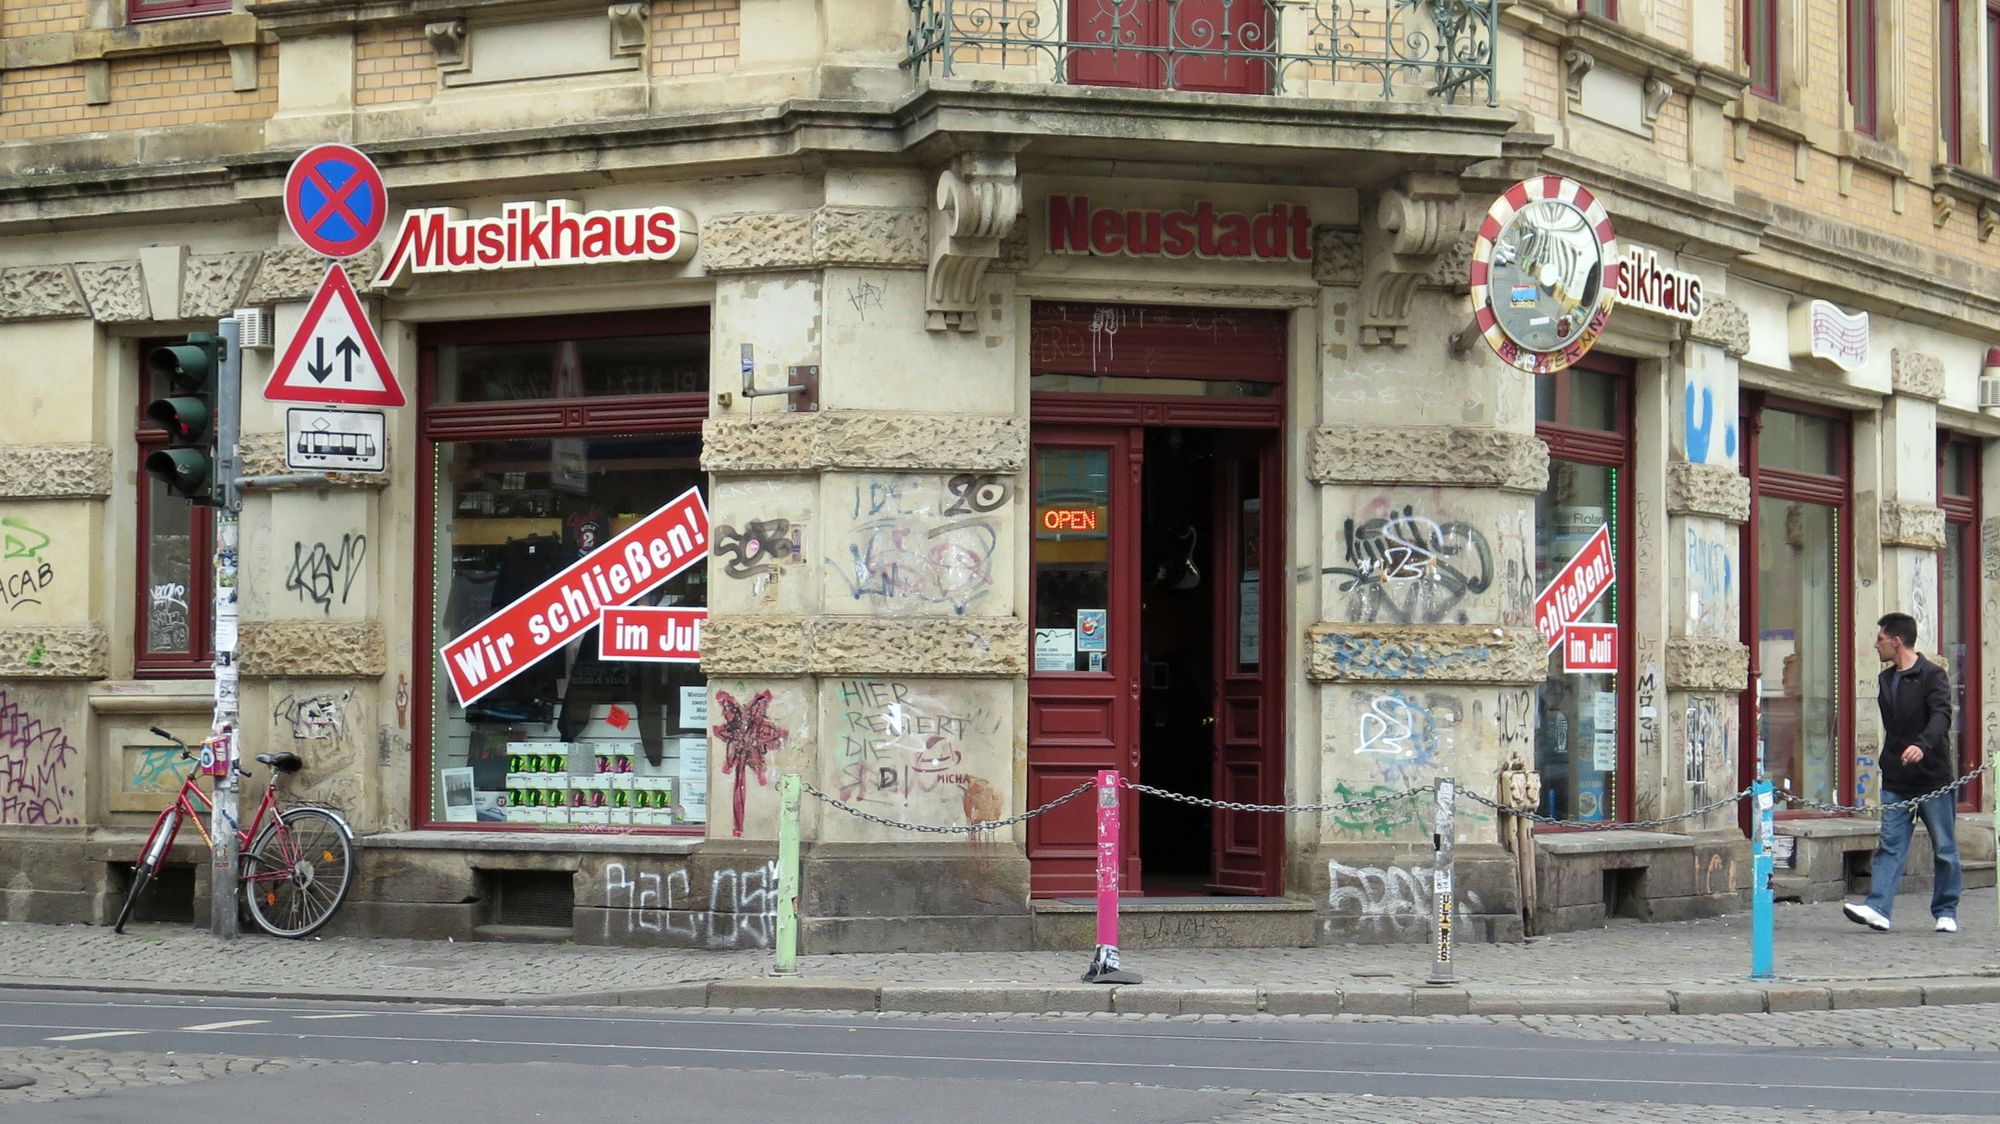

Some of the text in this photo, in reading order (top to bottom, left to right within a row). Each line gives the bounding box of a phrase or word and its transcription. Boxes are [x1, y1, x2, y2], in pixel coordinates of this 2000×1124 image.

[376, 204, 678, 282] Musikhaus
[1050, 195, 1311, 258] Neustadt
[1618, 250, 1701, 317] sikhaus
[1045, 510, 1095, 529] OPEN
[454, 506, 705, 688] Wir schließen!
[1540, 539, 1611, 642] chließen!
[615, 617, 700, 651] im Jul
[1570, 632, 1612, 664] im Juli
[841, 681, 915, 708] HIER
[842, 735, 892, 760] DIE
[937, 773, 971, 785] MICHA
